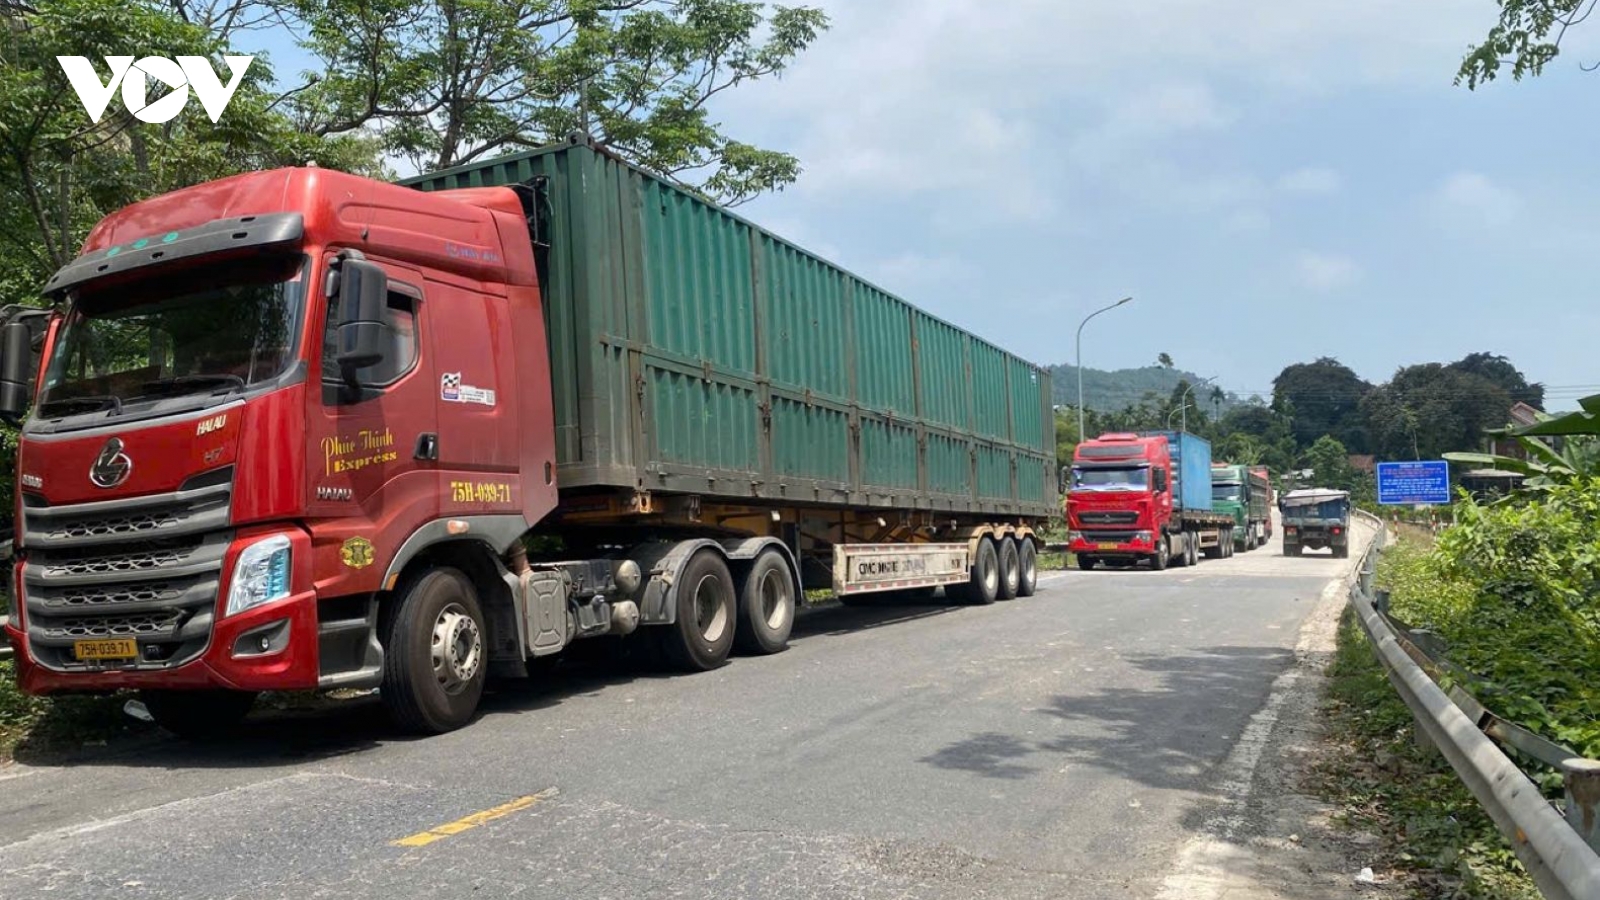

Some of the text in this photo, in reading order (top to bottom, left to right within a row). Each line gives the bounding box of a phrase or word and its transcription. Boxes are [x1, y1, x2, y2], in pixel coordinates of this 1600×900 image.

[334, 451, 397, 473] Express
[450, 481, 511, 502] 75H-039-71
[78, 642, 131, 656] 75H-039.71
